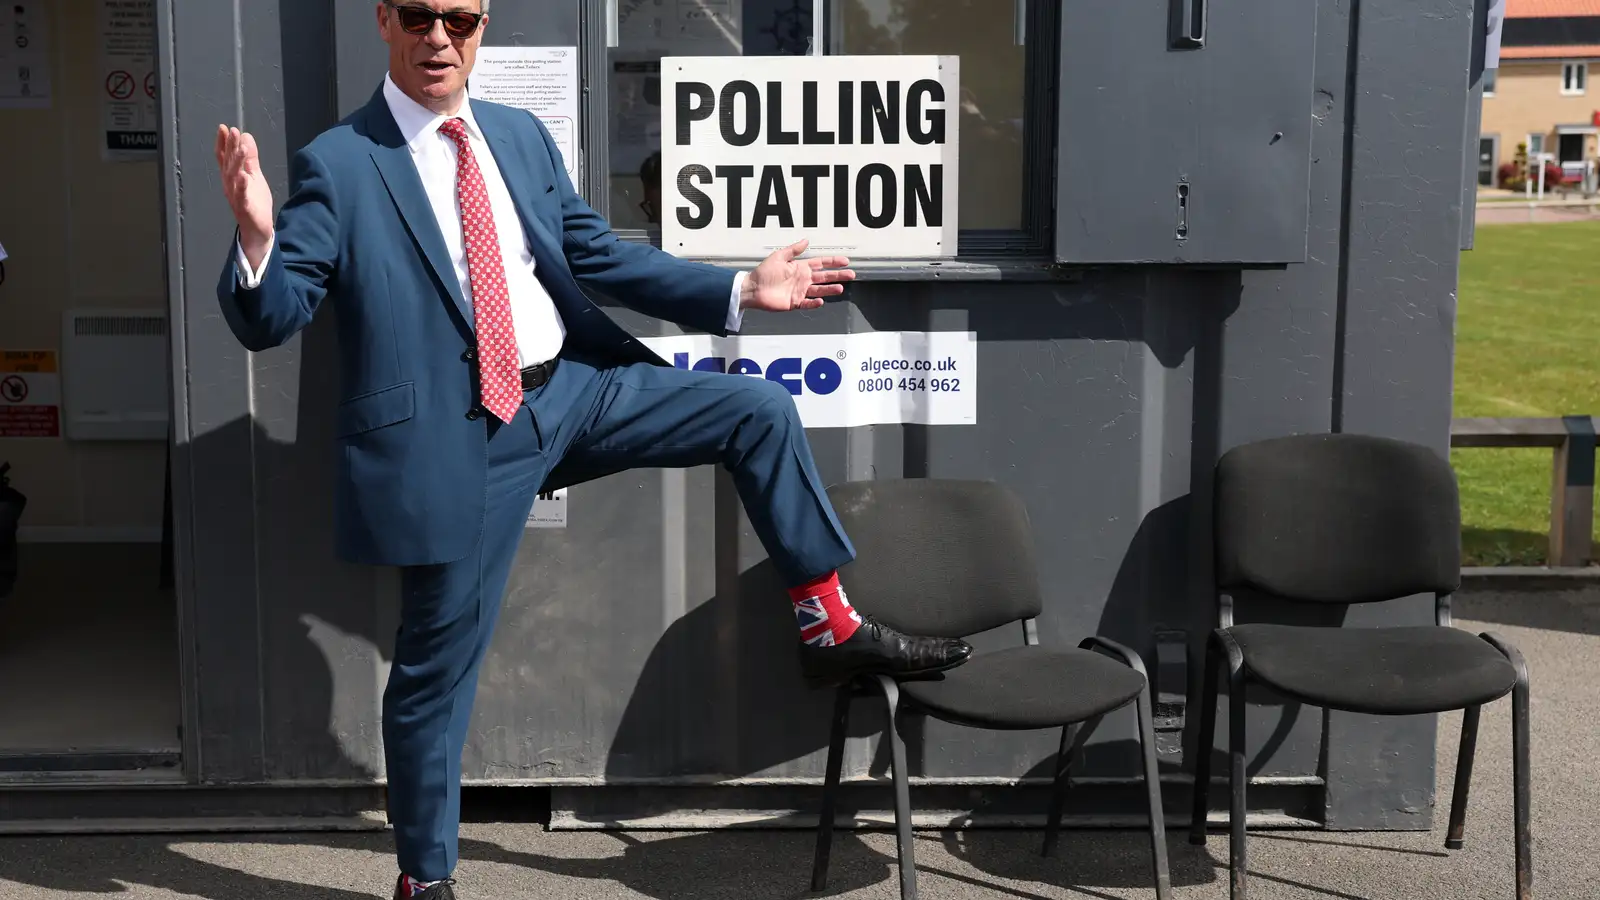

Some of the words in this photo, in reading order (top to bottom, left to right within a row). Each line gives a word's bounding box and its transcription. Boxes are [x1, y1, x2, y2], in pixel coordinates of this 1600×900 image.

[675, 79, 945, 146] POLLING
[676, 163, 943, 229] STATION
[858, 378, 893, 393] 0800
[898, 377, 926, 392] 454
[931, 378, 960, 392] 962
[861, 356, 957, 374] algeco.co.uk
